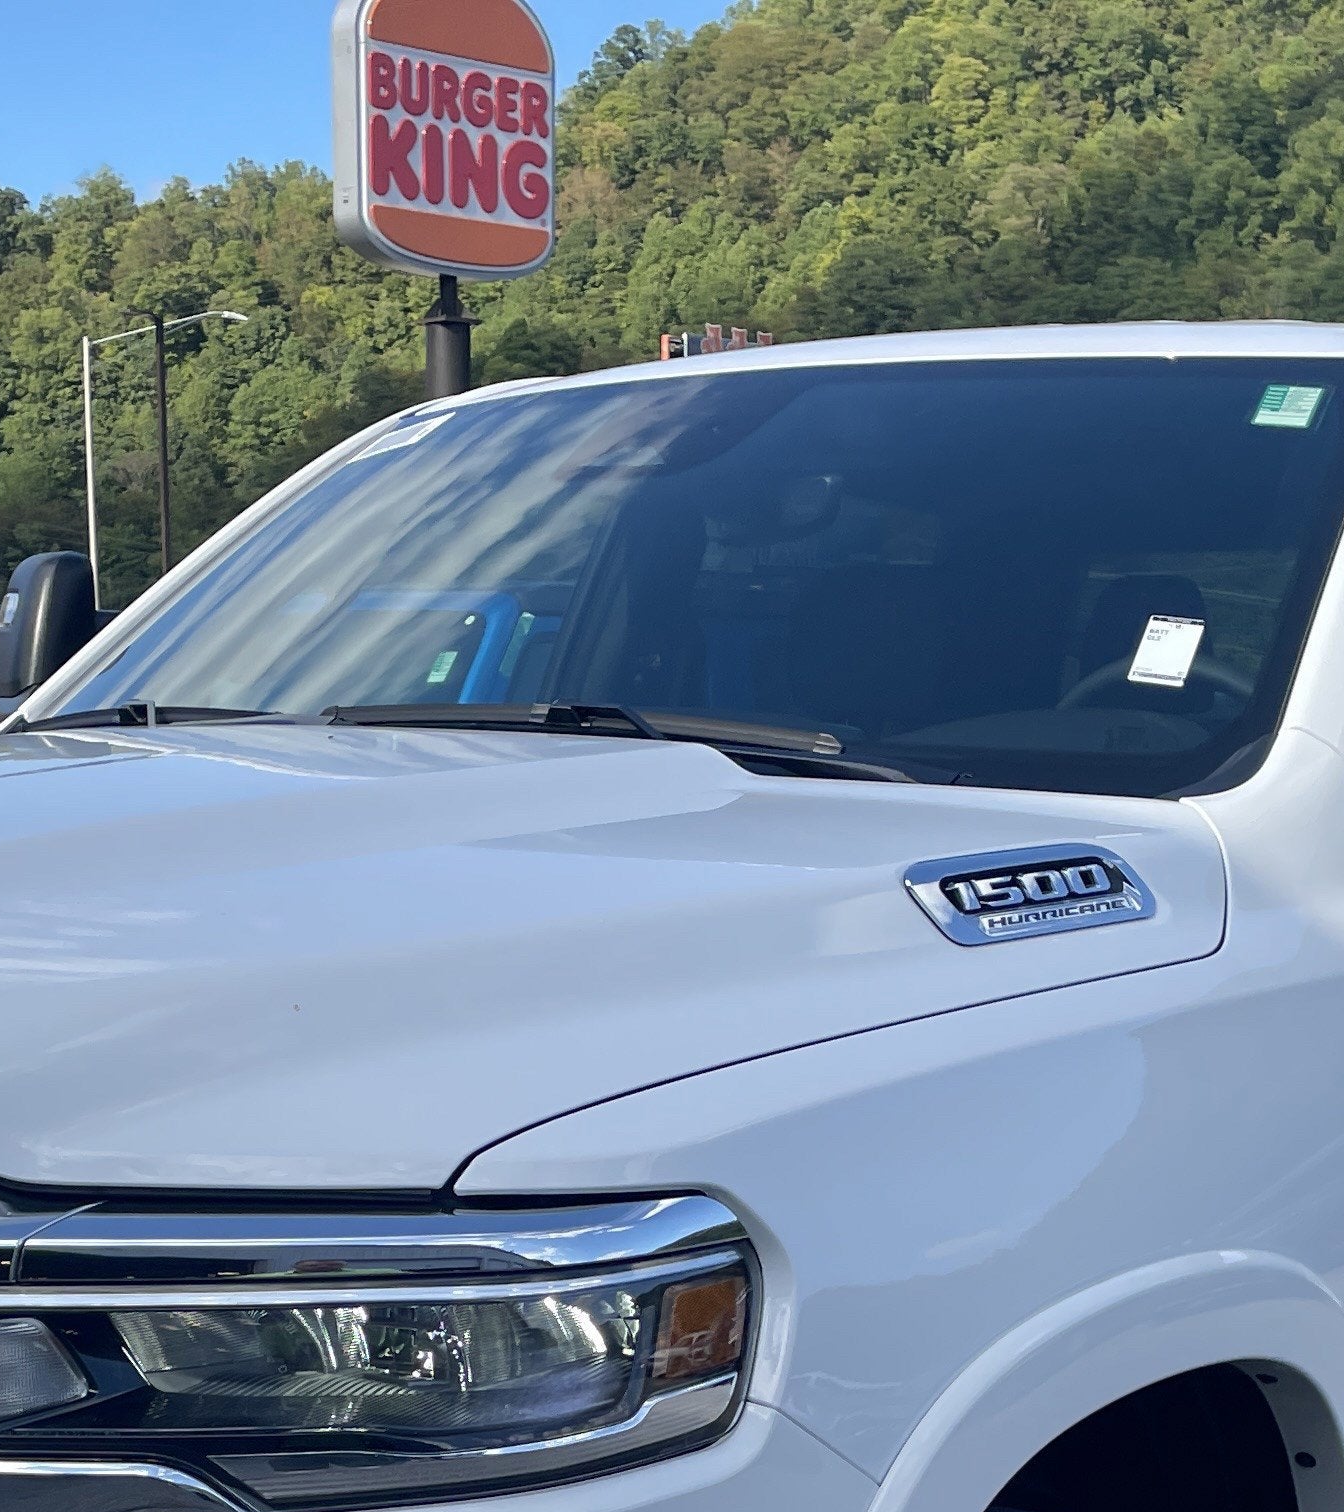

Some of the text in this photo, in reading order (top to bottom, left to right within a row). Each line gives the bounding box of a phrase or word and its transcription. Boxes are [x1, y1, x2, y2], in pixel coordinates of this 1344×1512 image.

[367, 51, 550, 138] BURGER
[369, 114, 550, 219] KING
[945, 863, 1112, 912] 1500
[988, 900, 1126, 929] HURRICANE
